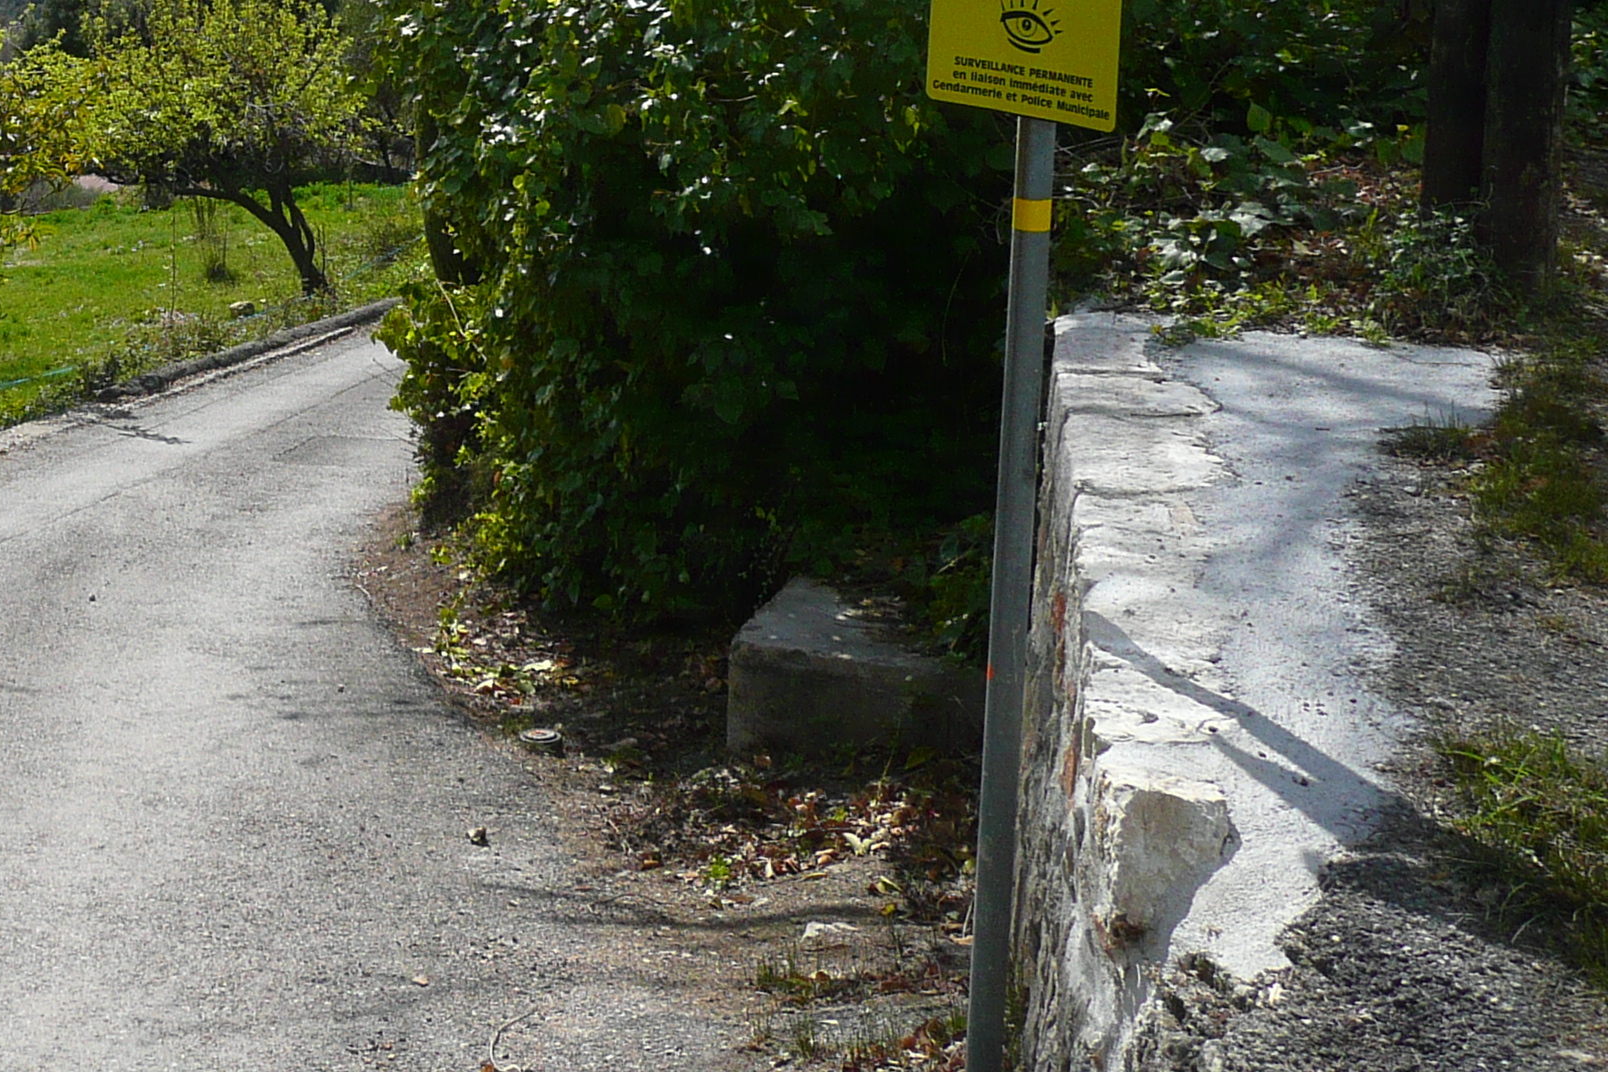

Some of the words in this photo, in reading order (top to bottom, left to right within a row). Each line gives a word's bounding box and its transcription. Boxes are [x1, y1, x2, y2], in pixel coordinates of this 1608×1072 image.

[952, 69, 967, 81] en
[970, 72, 1006, 87] liaison
[1009, 78, 1067, 98] immédiate
[1070, 89, 1094, 103] avec
[954, 55, 1026, 77] SURVEILLANCE
[1029, 67, 1094, 89] PERMANENTE
[932, 79, 1003, 100] Gendarmerie
[1006, 91, 1018, 102] et
[1021, 93, 1053, 109] Police
[1056, 99, 1111, 121] Municipale
